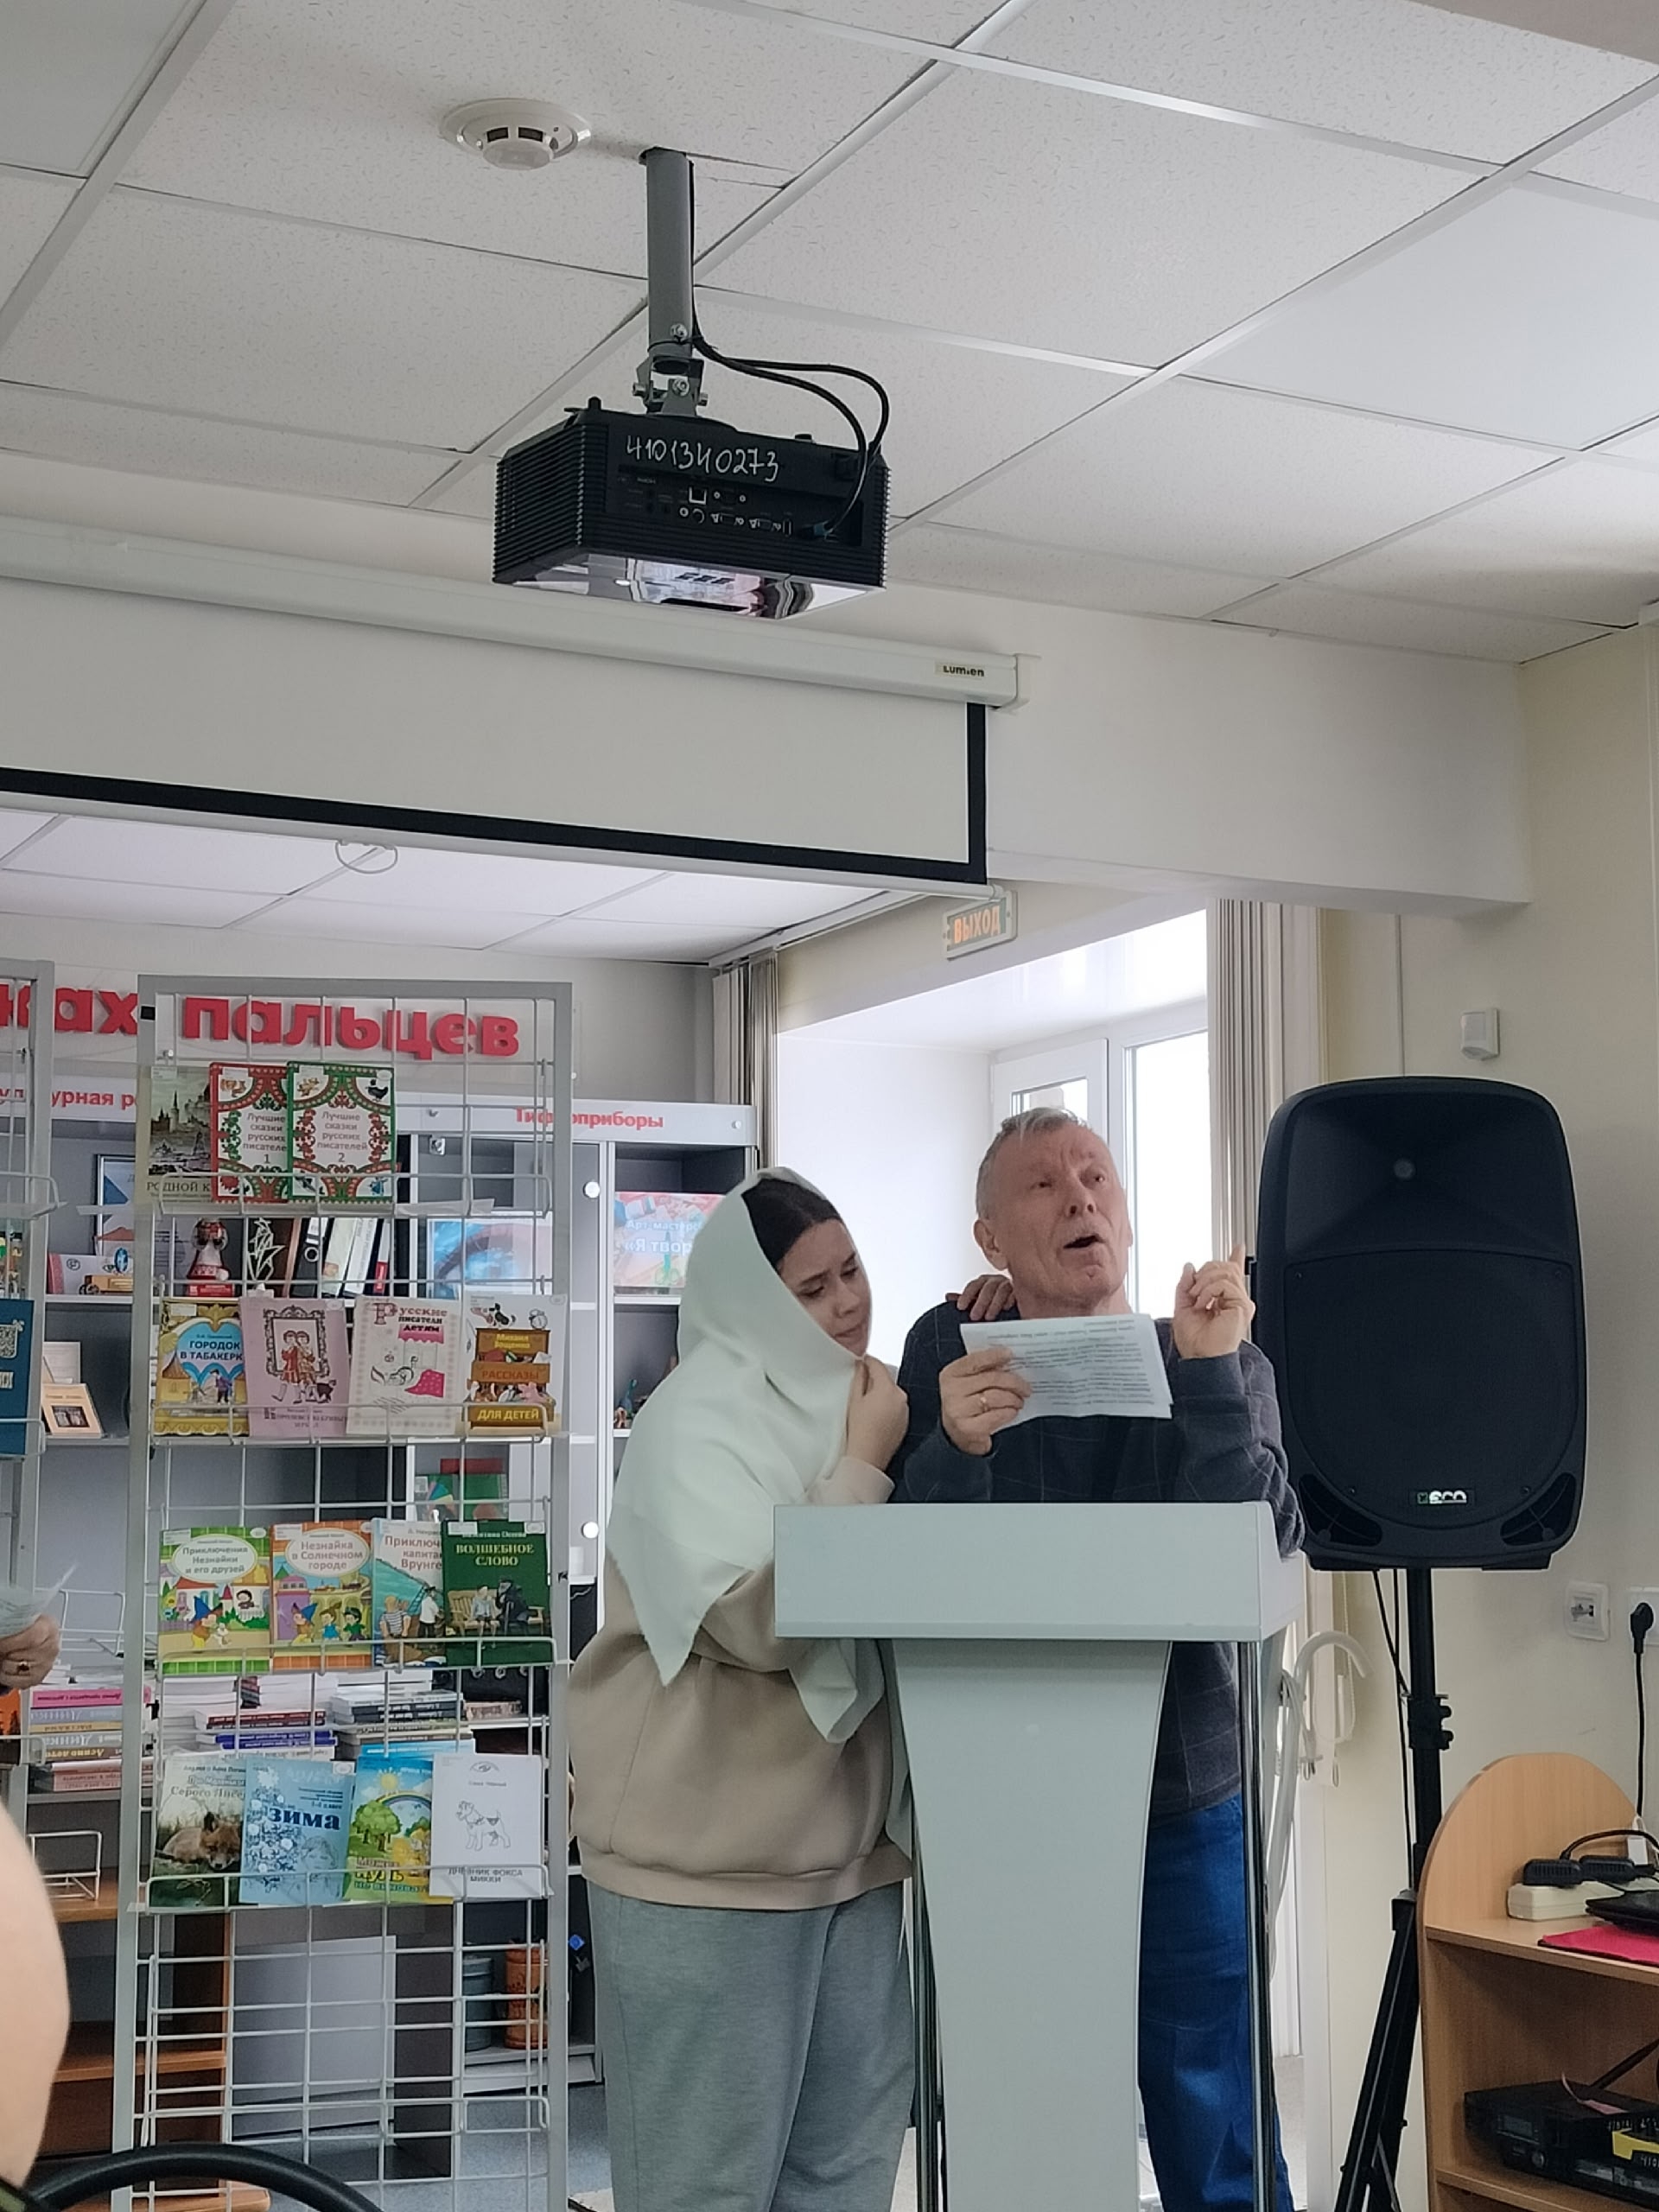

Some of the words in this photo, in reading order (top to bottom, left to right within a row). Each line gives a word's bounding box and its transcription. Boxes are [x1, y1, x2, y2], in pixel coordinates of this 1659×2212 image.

[626, 435, 779, 481] 4101340273
[954, 905, 1001, 944] ВЫХОД
[181, 996, 520, 1061] пальцев
[247, 1112, 286, 1123] Лучшие
[321, 1110, 361, 1122] Лучшие
[250, 1123, 283, 1133] сказки
[324, 1122, 358, 1131] сказки
[321, 1132, 361, 1141] русских
[316, 1141, 369, 1151] писателей
[263, 1154, 271, 1165] 1
[338, 1152, 346, 1163] 2
[189, 1340, 240, 1351] ГОРОДОК
[180, 1351, 187, 1359] В
[482, 1370, 539, 1381] РАССКАЗЫ
[477, 1409, 501, 1421] ДЛЯ
[503, 1408, 539, 1421] ДЕТЕЙ
[301, 1540, 353, 1550] Незнайка
[456, 1543, 534, 1554] ВОЛШЕБНОЕ
[182, 1546, 248, 1556] Приключения
[301, 1550, 363, 1560] Солнечном
[192, 1555, 238, 1564] Незнайки
[475, 1555, 518, 1566] СЛОВО
[210, 1565, 245, 1575] друзей
[308, 1562, 347, 1572] городе
